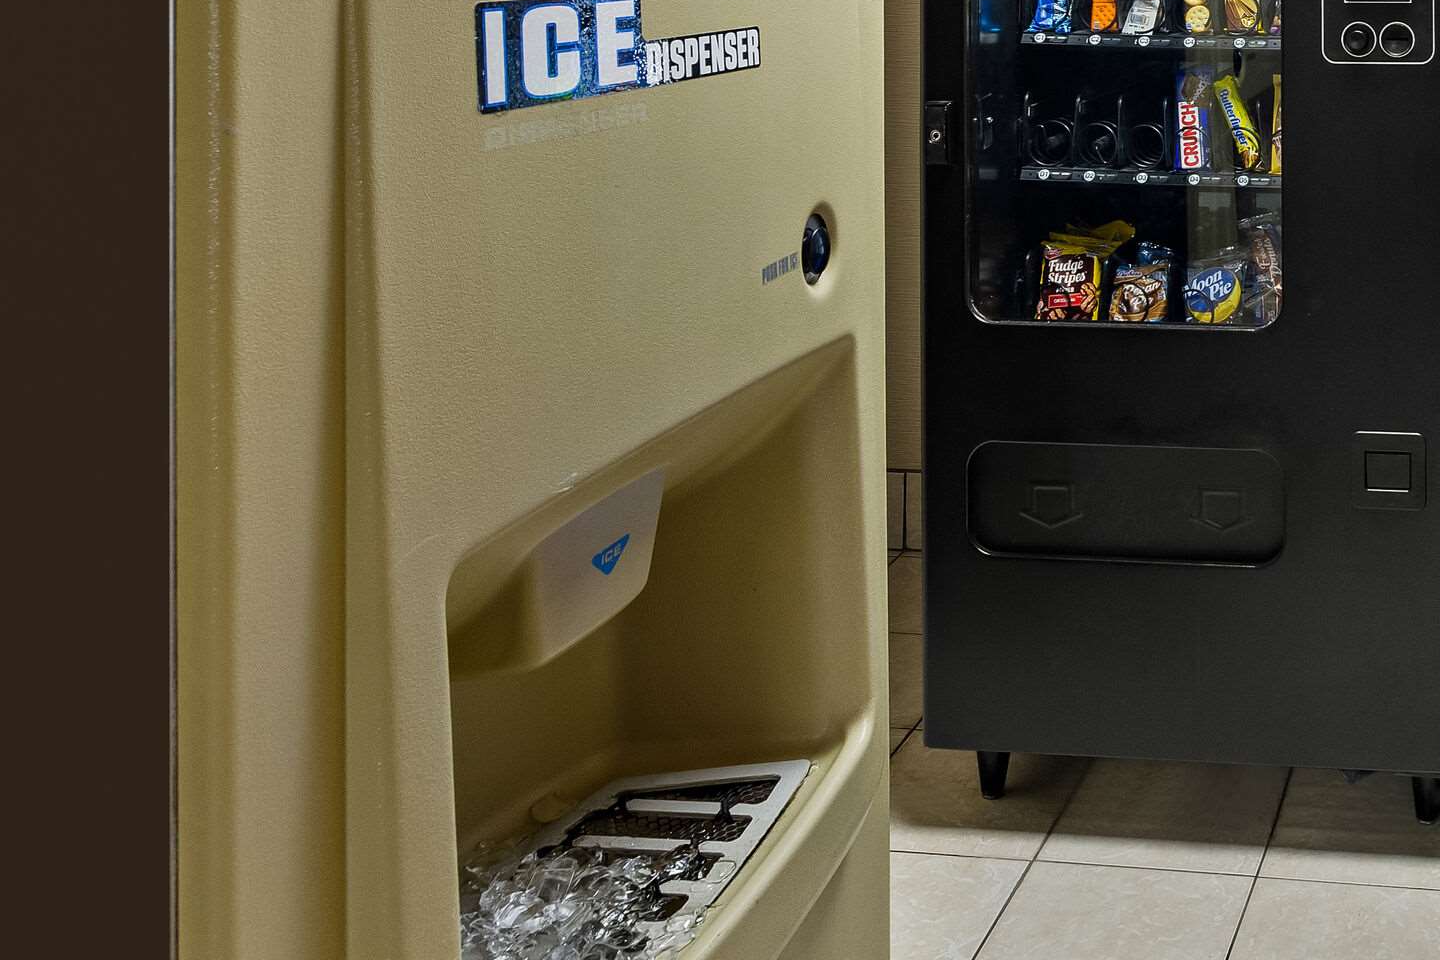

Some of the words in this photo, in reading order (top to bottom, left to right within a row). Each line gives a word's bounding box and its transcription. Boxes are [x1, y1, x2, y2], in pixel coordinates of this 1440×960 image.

[645, 28, 760, 86] DISPENSER
[1181, 102, 1200, 167] CRUNCH
[1048, 260, 1084, 273] Fudge
[1048, 271, 1087, 286] Stripes
[1183, 270, 1223, 293] Moon
[1209, 281, 1232, 301] Pie
[601, 543, 622, 566] ICE
